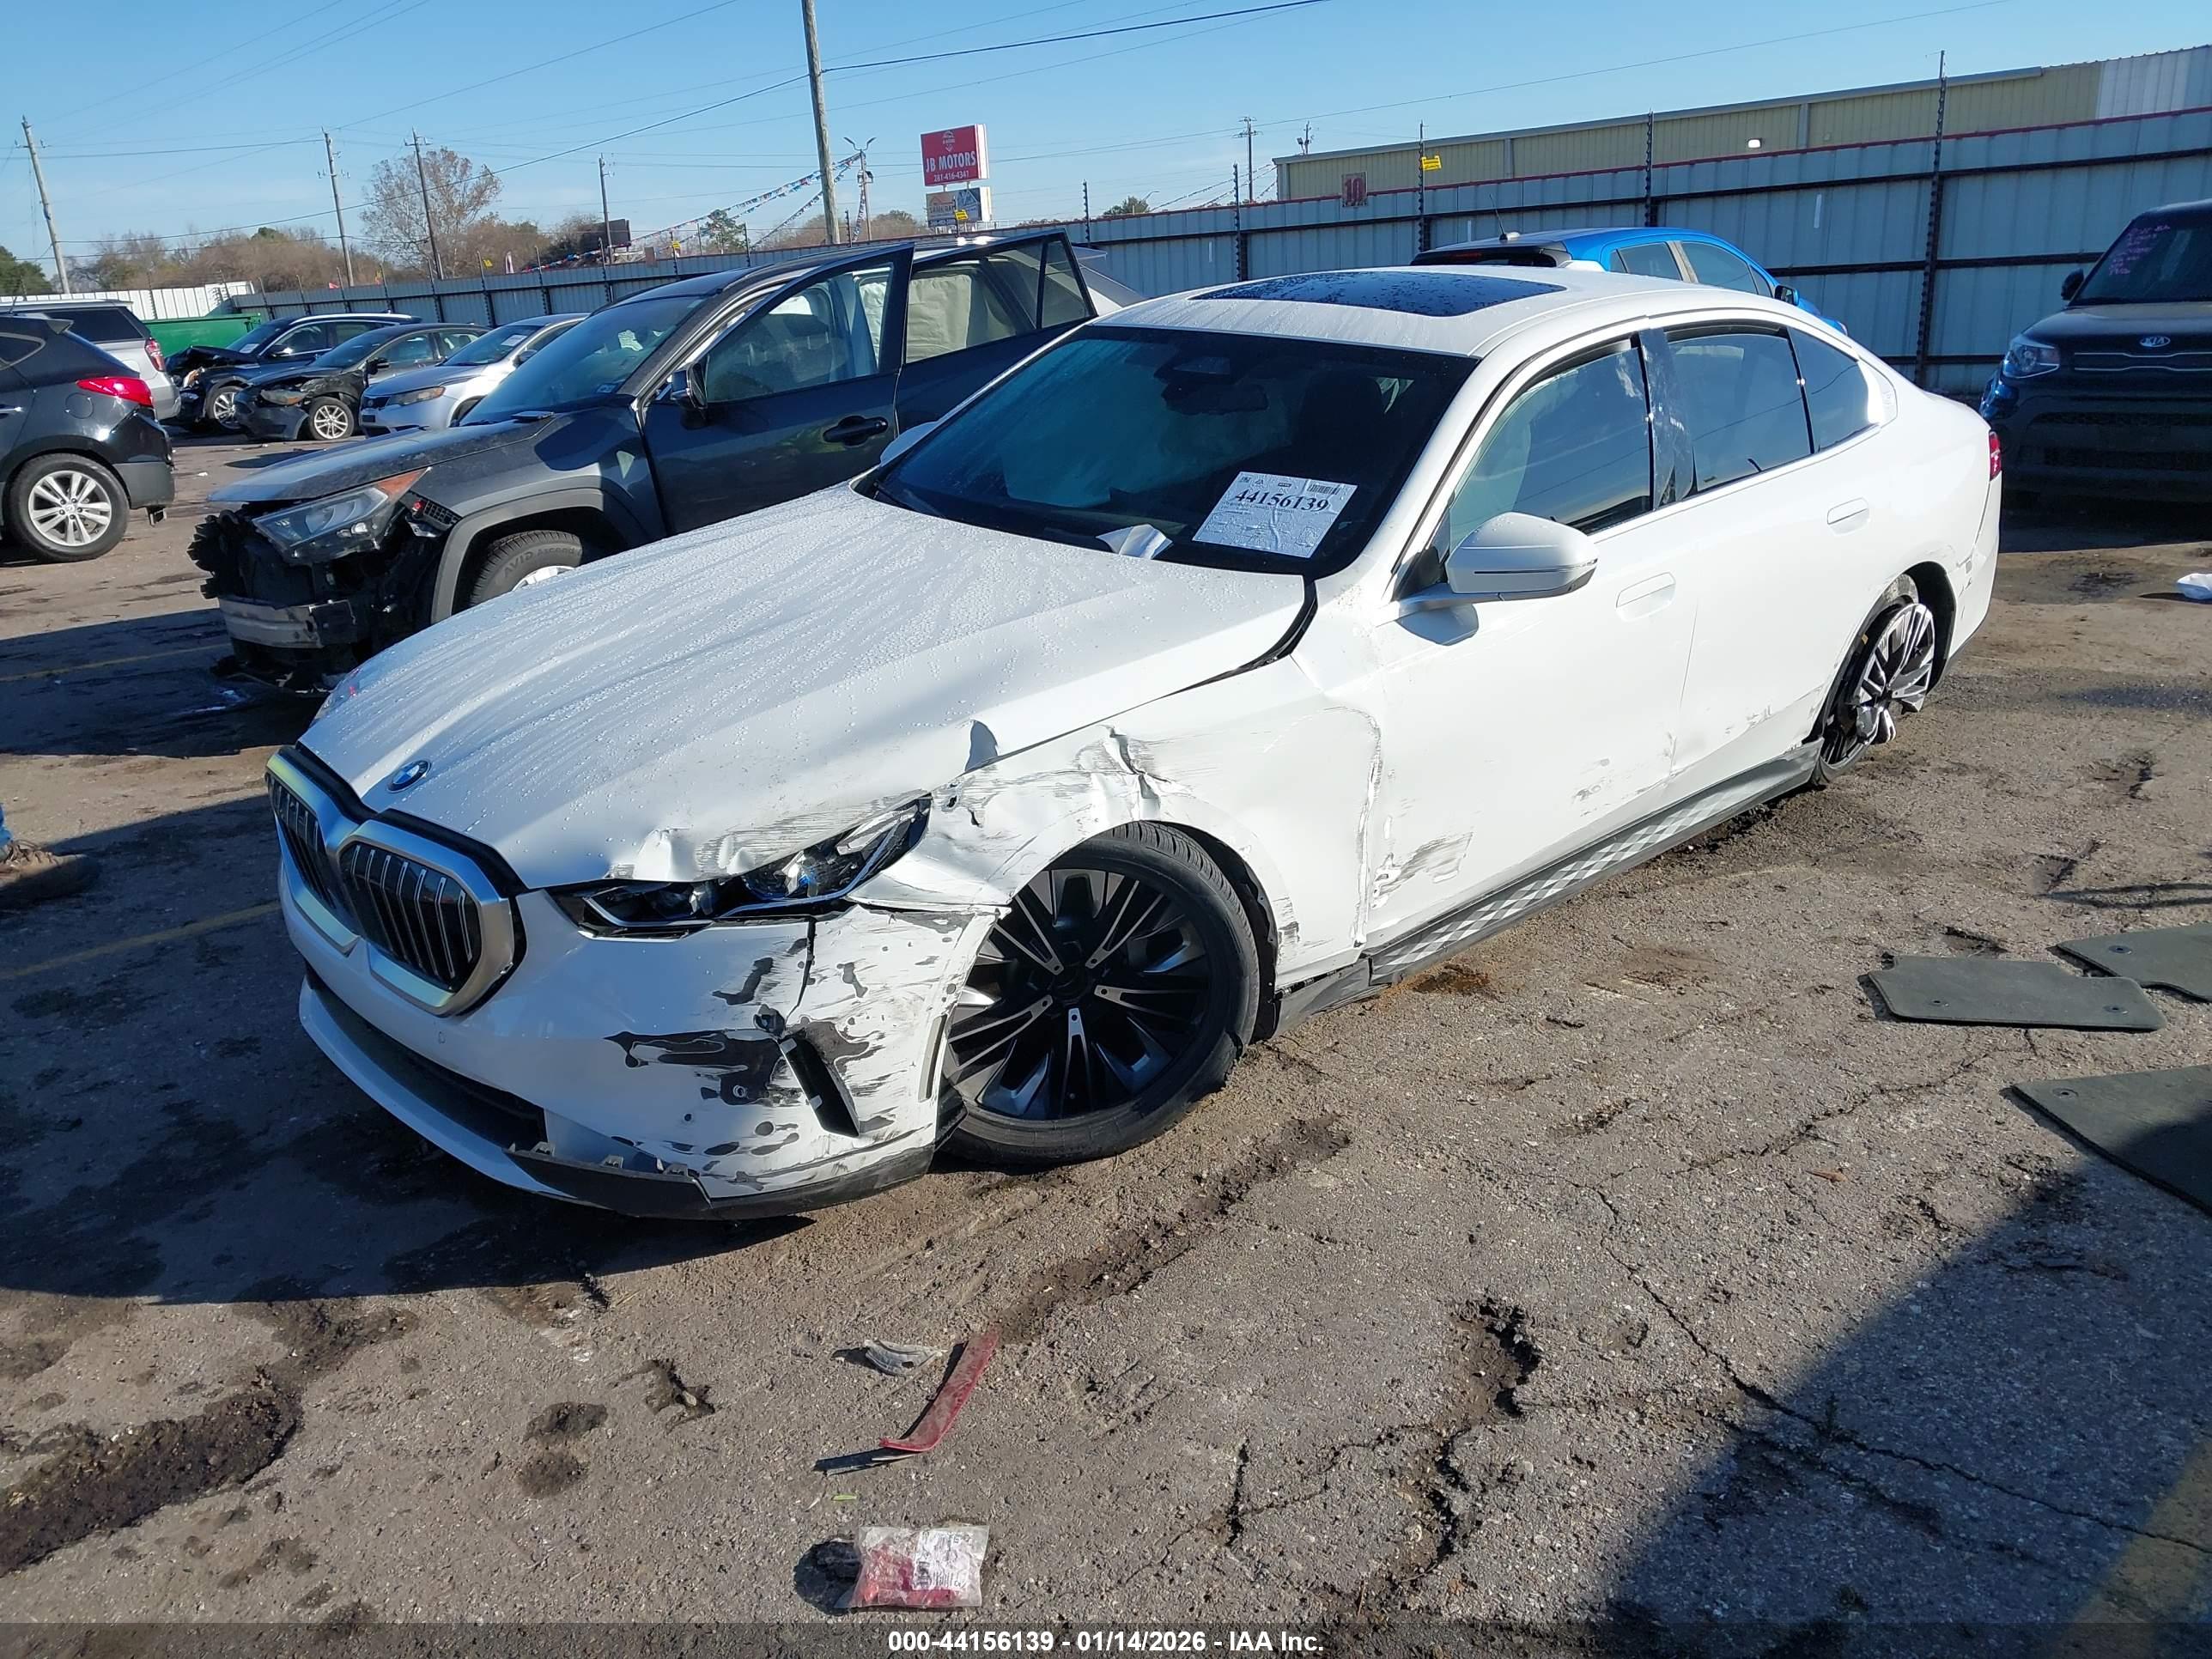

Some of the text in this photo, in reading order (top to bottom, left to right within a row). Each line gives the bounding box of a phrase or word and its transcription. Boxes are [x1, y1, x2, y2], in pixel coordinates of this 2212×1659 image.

[926, 150, 976, 173] JB MOTORS
[1235, 489, 1329, 513] 44156139
[502, 551, 533, 578] AVID
